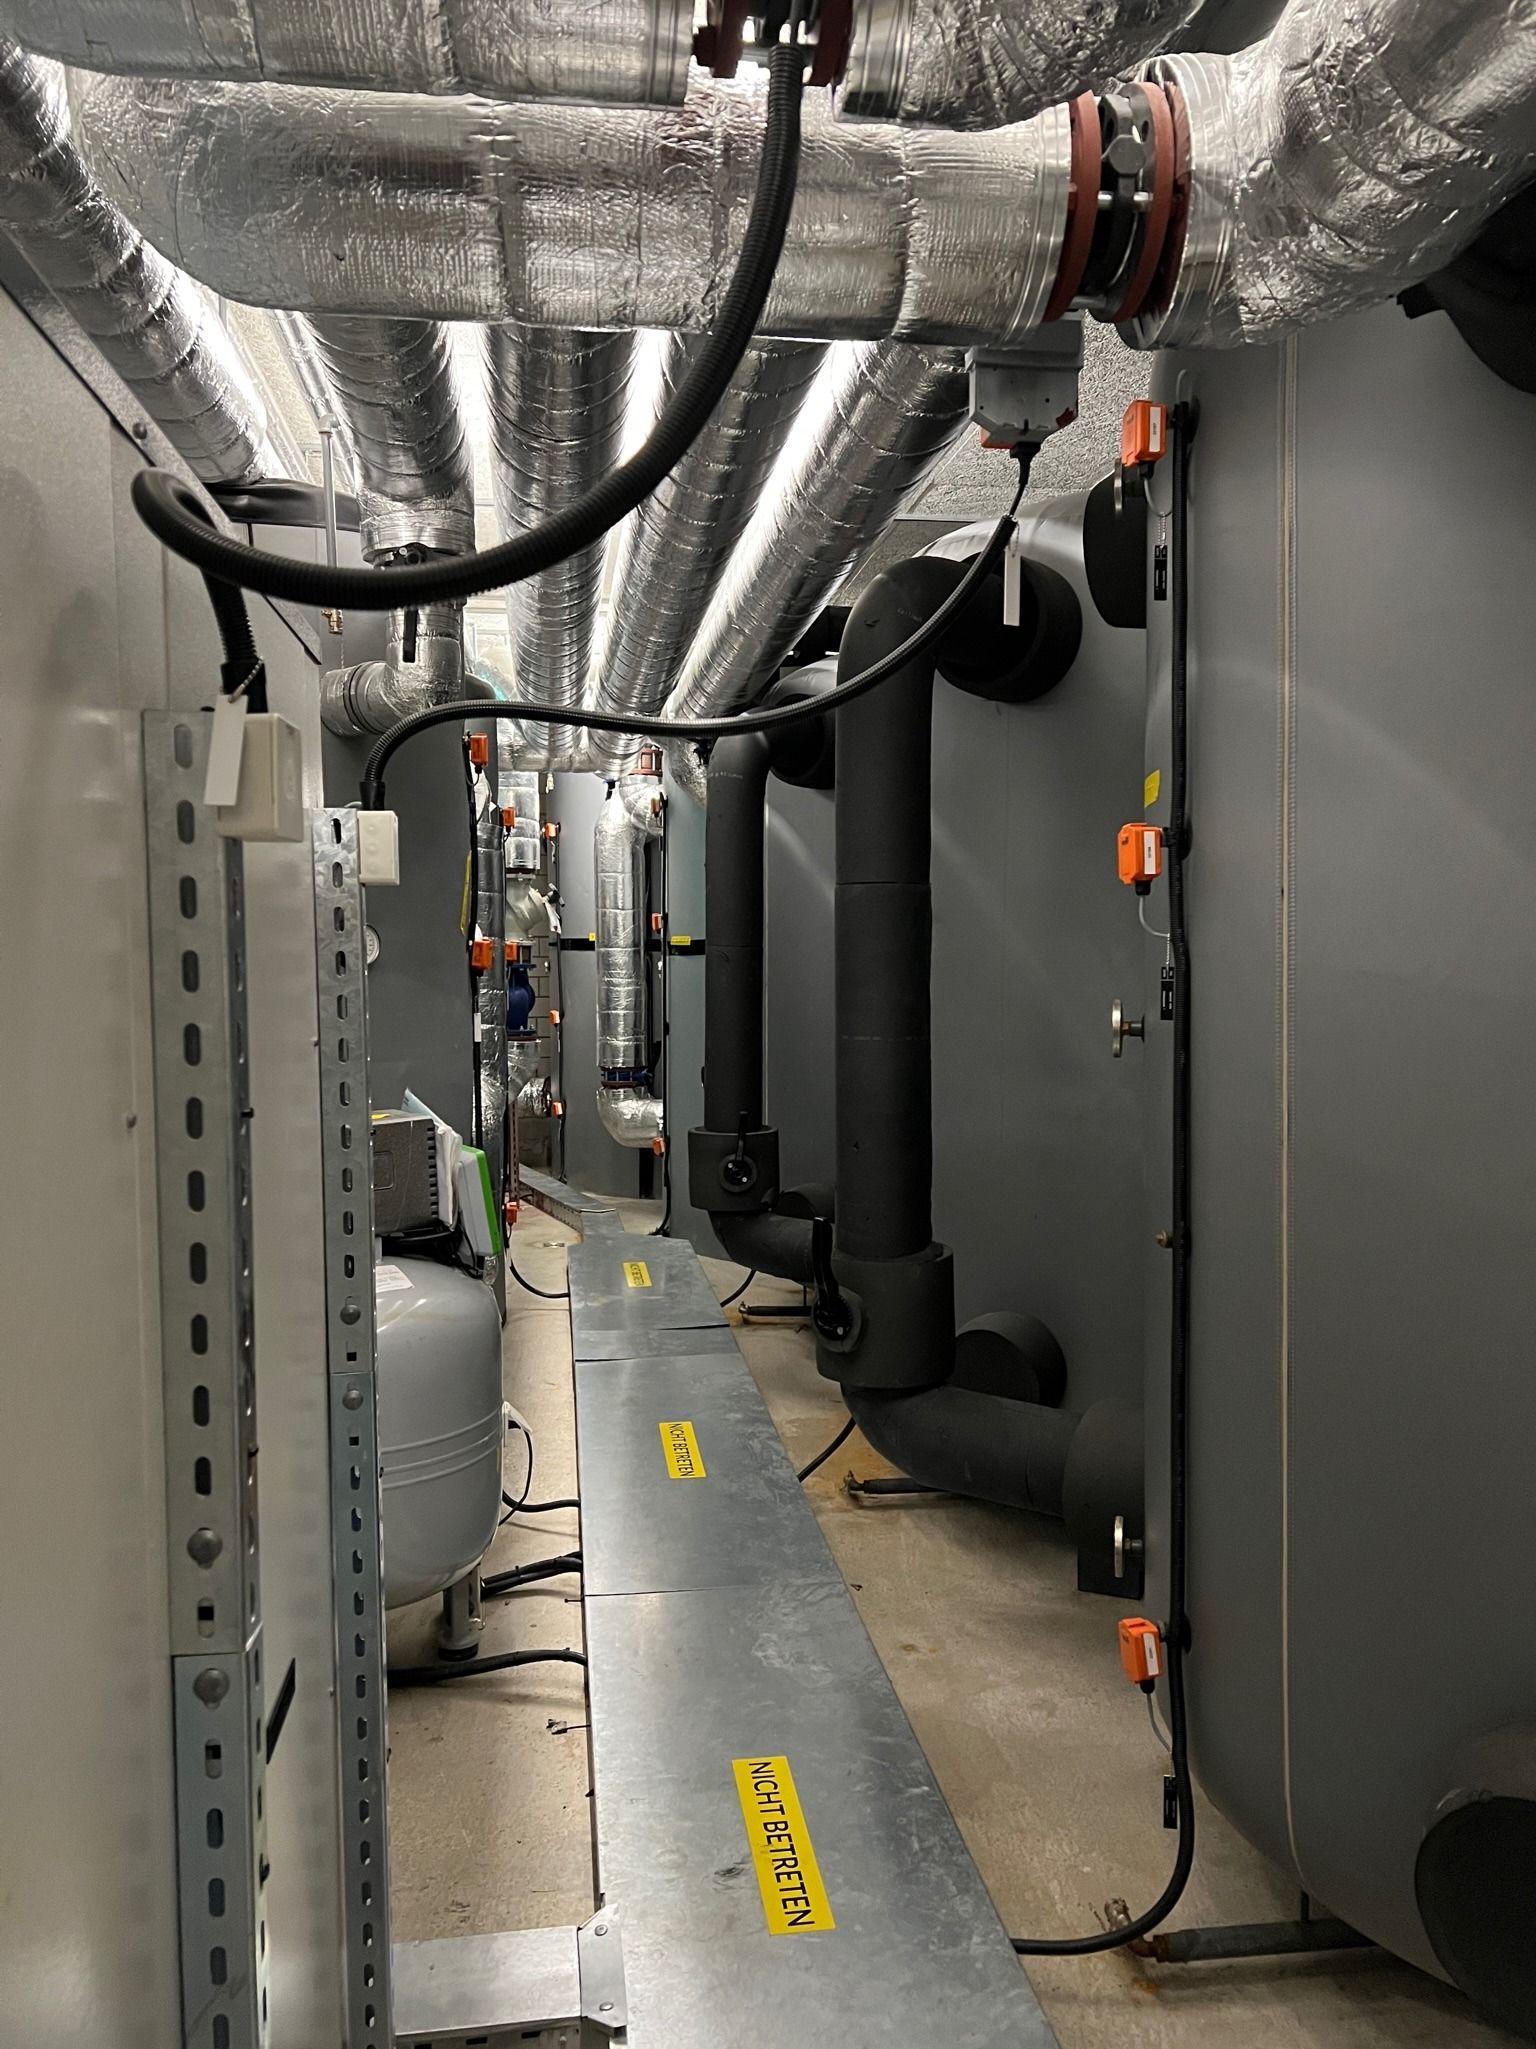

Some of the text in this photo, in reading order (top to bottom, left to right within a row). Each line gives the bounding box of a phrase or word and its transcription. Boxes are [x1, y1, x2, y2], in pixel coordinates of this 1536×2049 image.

[672, 1443, 695, 1477] BETRETEN
[748, 1761, 815, 1927] NICHT BETRETEN
